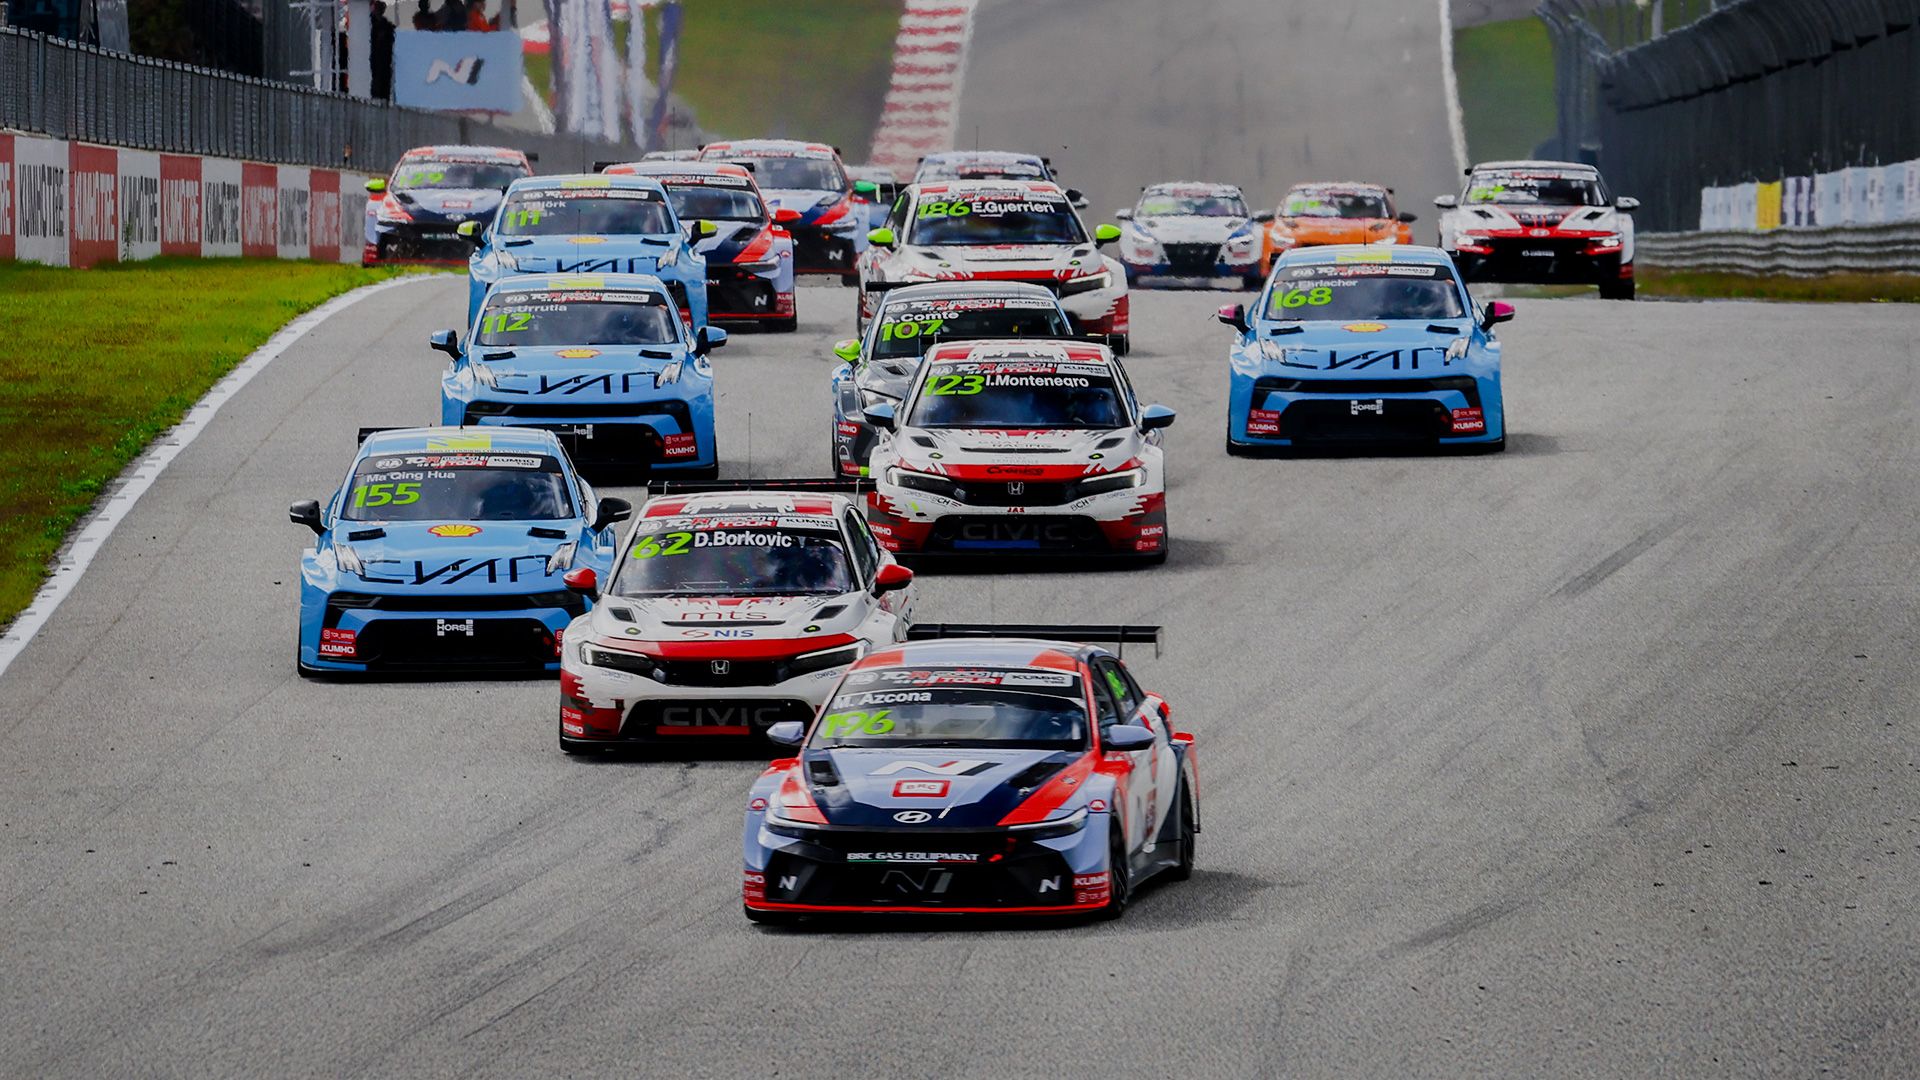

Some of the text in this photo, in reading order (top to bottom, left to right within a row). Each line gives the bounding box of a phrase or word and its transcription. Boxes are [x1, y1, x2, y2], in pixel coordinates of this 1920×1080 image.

[917, 200, 971, 218] 186
[506, 210, 541, 228] 111
[1273, 287, 1333, 310] 168
[503, 304, 568, 313] S.Urrutia
[482, 312, 534, 335] 112
[882, 312, 960, 325] A.Comte
[880, 319, 944, 342] 107
[923, 375, 985, 397] 123
[665, 445, 697, 455] KUMHO
[428, 471, 456, 479] Hua
[353, 482, 422, 508] 155
[632, 531, 793, 560] 62 D.Borkovic
[681, 611, 768, 620] mts
[437, 619, 474, 636] HORSE
[321, 644, 355, 654] KUMHO
[858, 692, 933, 706] Azcona
[662, 707, 781, 727] CIVIC
[822, 709, 897, 738] 196
[905, 852, 980, 860] EQUIPMENT
[1039, 875, 1062, 893] N
